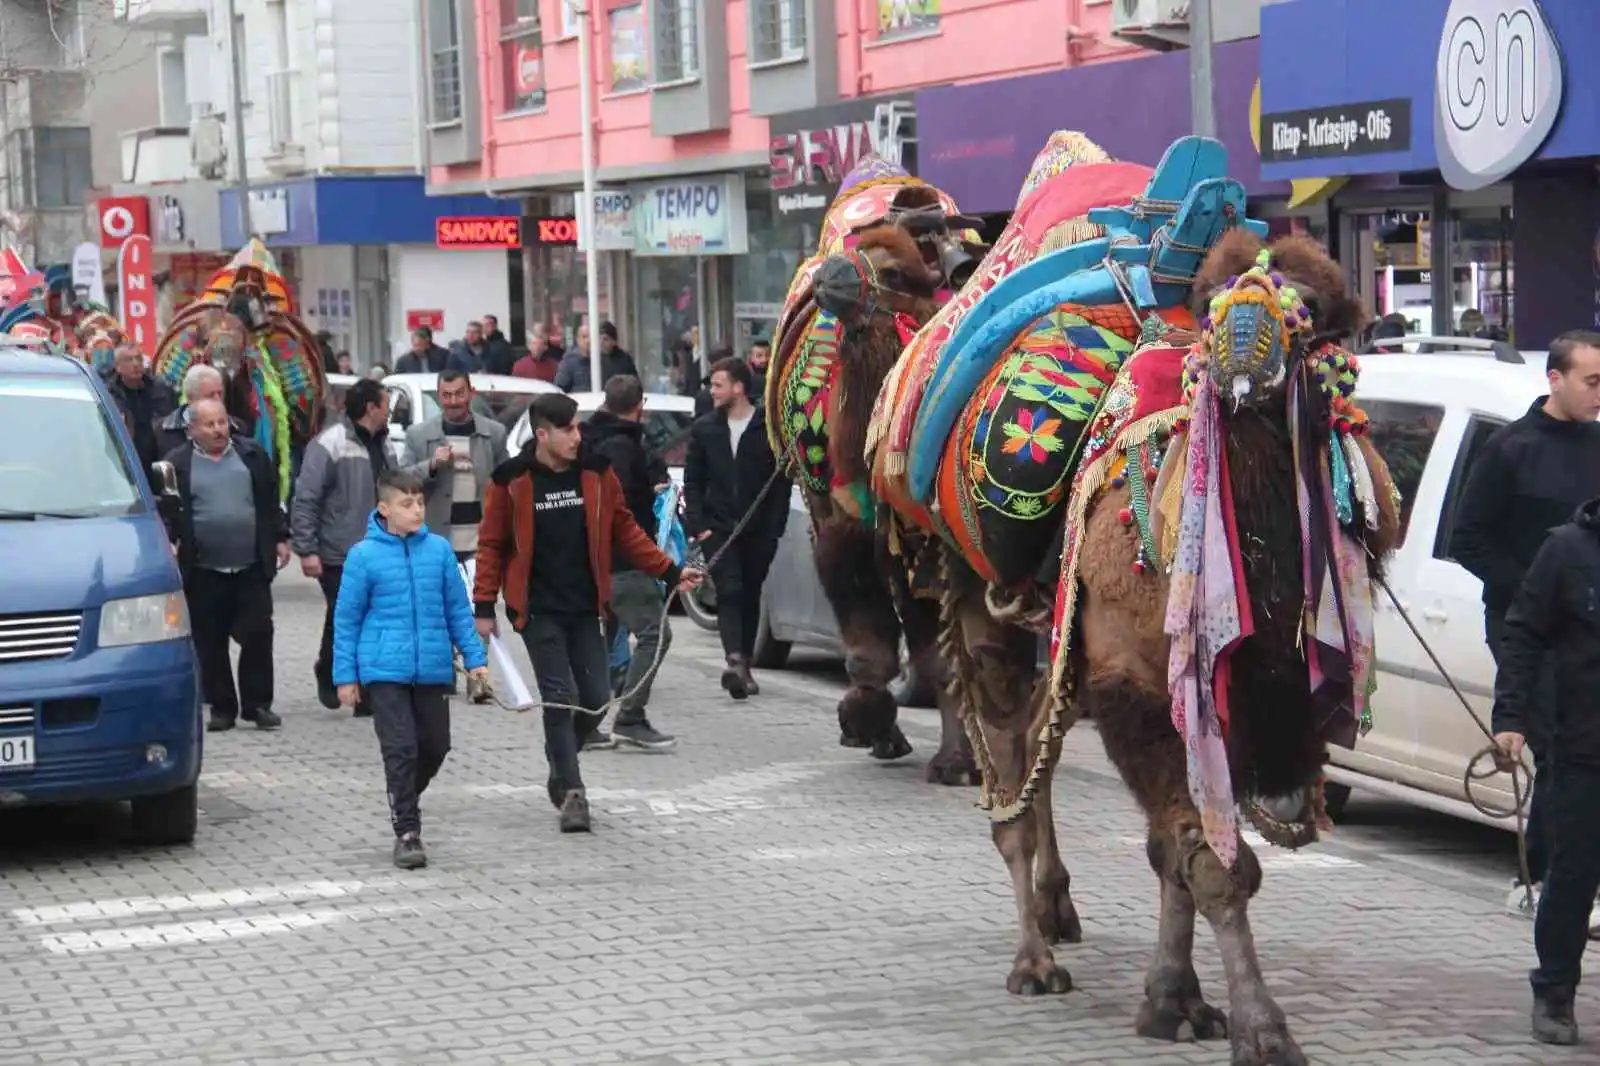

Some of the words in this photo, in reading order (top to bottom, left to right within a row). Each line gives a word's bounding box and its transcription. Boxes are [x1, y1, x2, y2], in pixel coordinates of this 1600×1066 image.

[1446, 8, 1536, 131] cn
[1272, 121, 1300, 155] Kitap
[1367, 109, 1392, 141] Ofis
[593, 194, 633, 215] EMPO
[655, 184, 720, 219] TEMPO
[2, 739, 28, 762] 01
